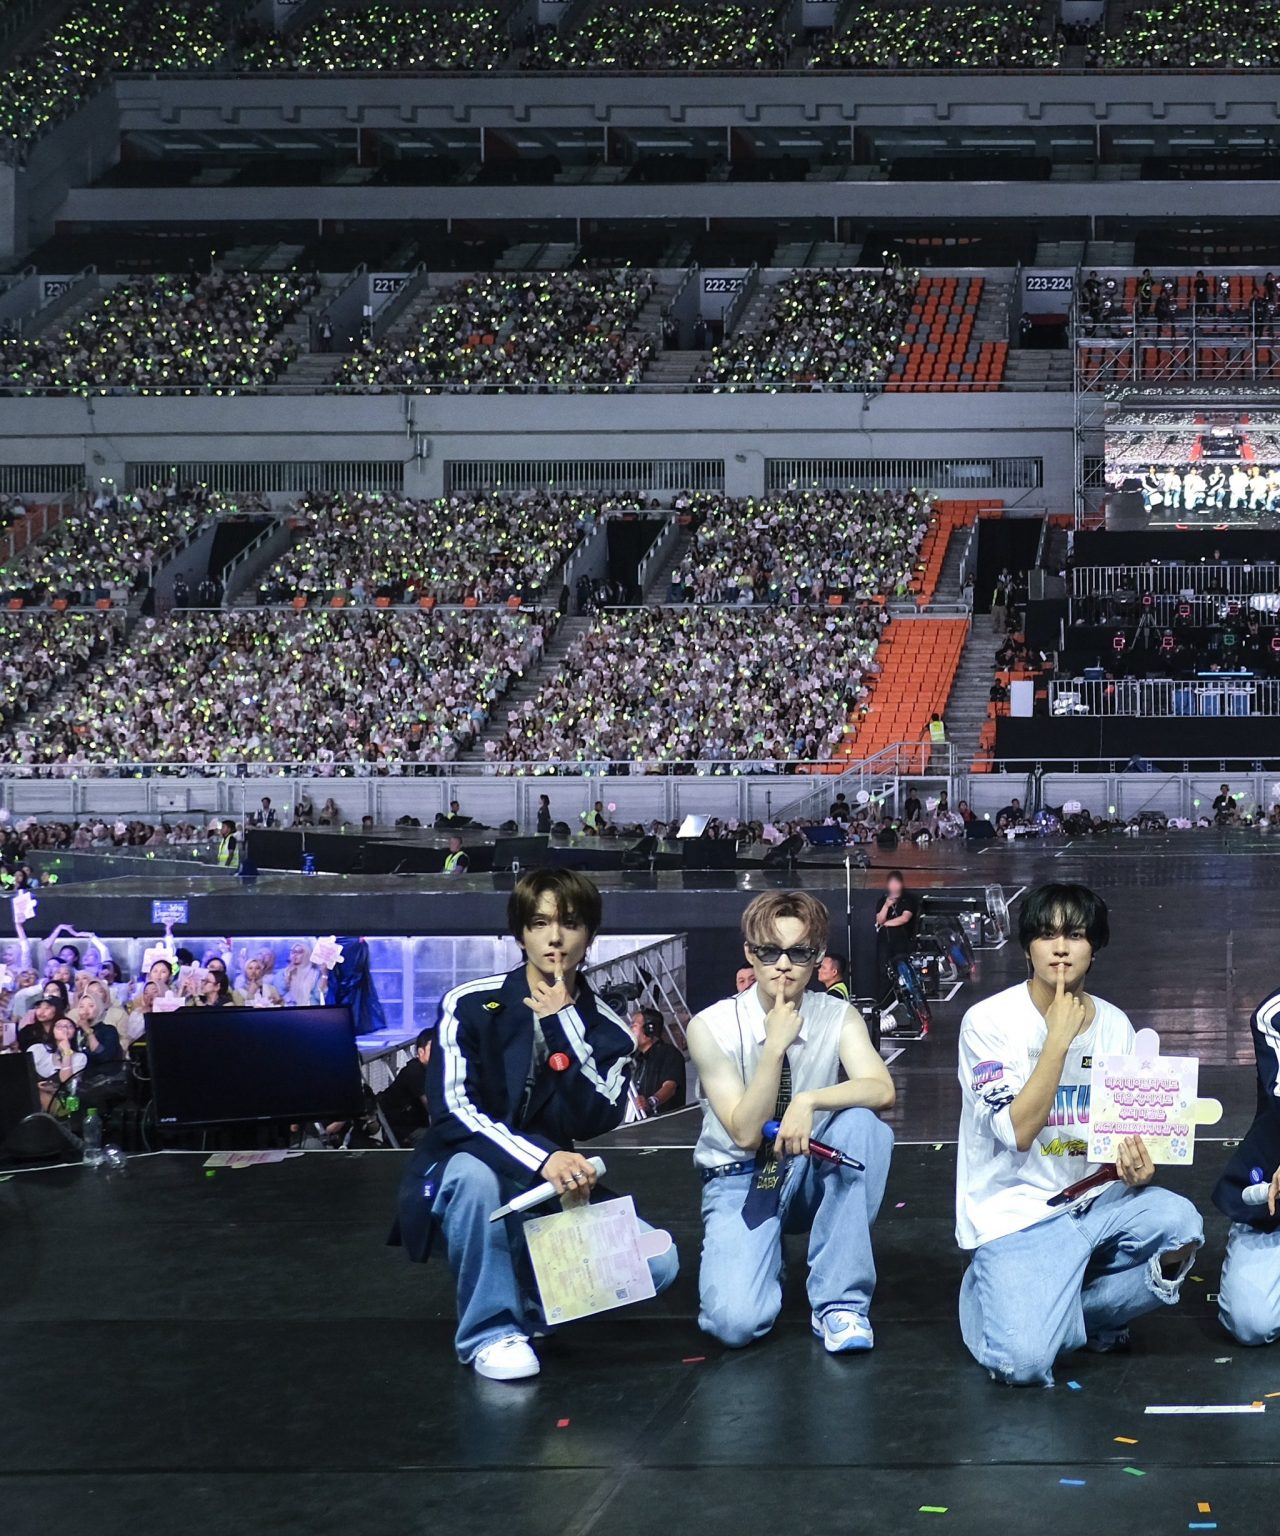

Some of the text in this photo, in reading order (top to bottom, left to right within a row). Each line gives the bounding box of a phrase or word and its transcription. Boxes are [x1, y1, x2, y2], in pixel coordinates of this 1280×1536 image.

[1027, 278, 1072, 290] 223-224
[763, 1161, 778, 1174] ME
[757, 1176, 779, 1189] BABY
